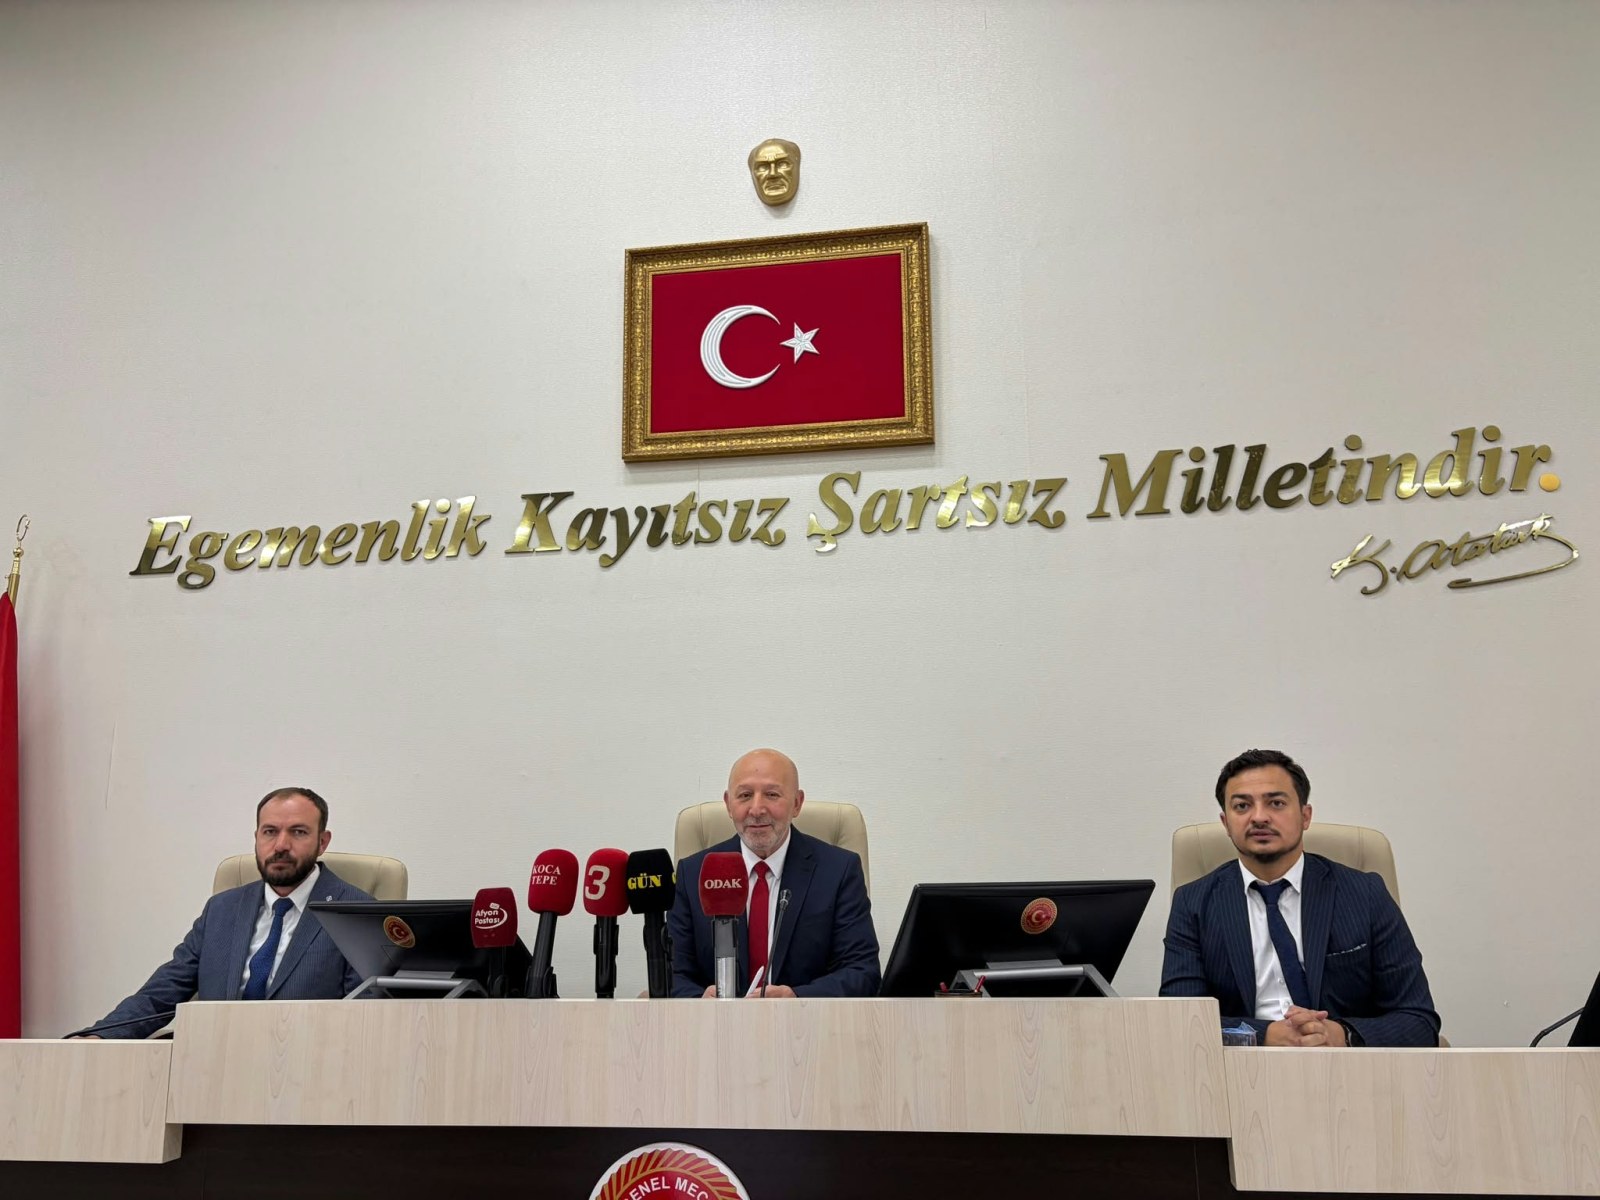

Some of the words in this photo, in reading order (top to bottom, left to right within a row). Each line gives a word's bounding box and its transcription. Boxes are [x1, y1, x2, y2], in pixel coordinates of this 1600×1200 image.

[129, 495, 491, 589] Egemenlik
[505, 490, 790, 567] Kayıtsız
[806, 469, 1067, 553] Şartsız
[1087, 425, 1561, 518] Milletindir.
[532, 864, 561, 875] KOCA
[531, 875, 558, 886] TEPE
[584, 864, 611, 901] 3
[627, 872, 662, 890] GÜN
[704, 878, 743, 890] ODAK
[475, 908, 499, 918] Afyon
[474, 917, 500, 925] Postası
[624, 1176, 671, 1200] ENEL
